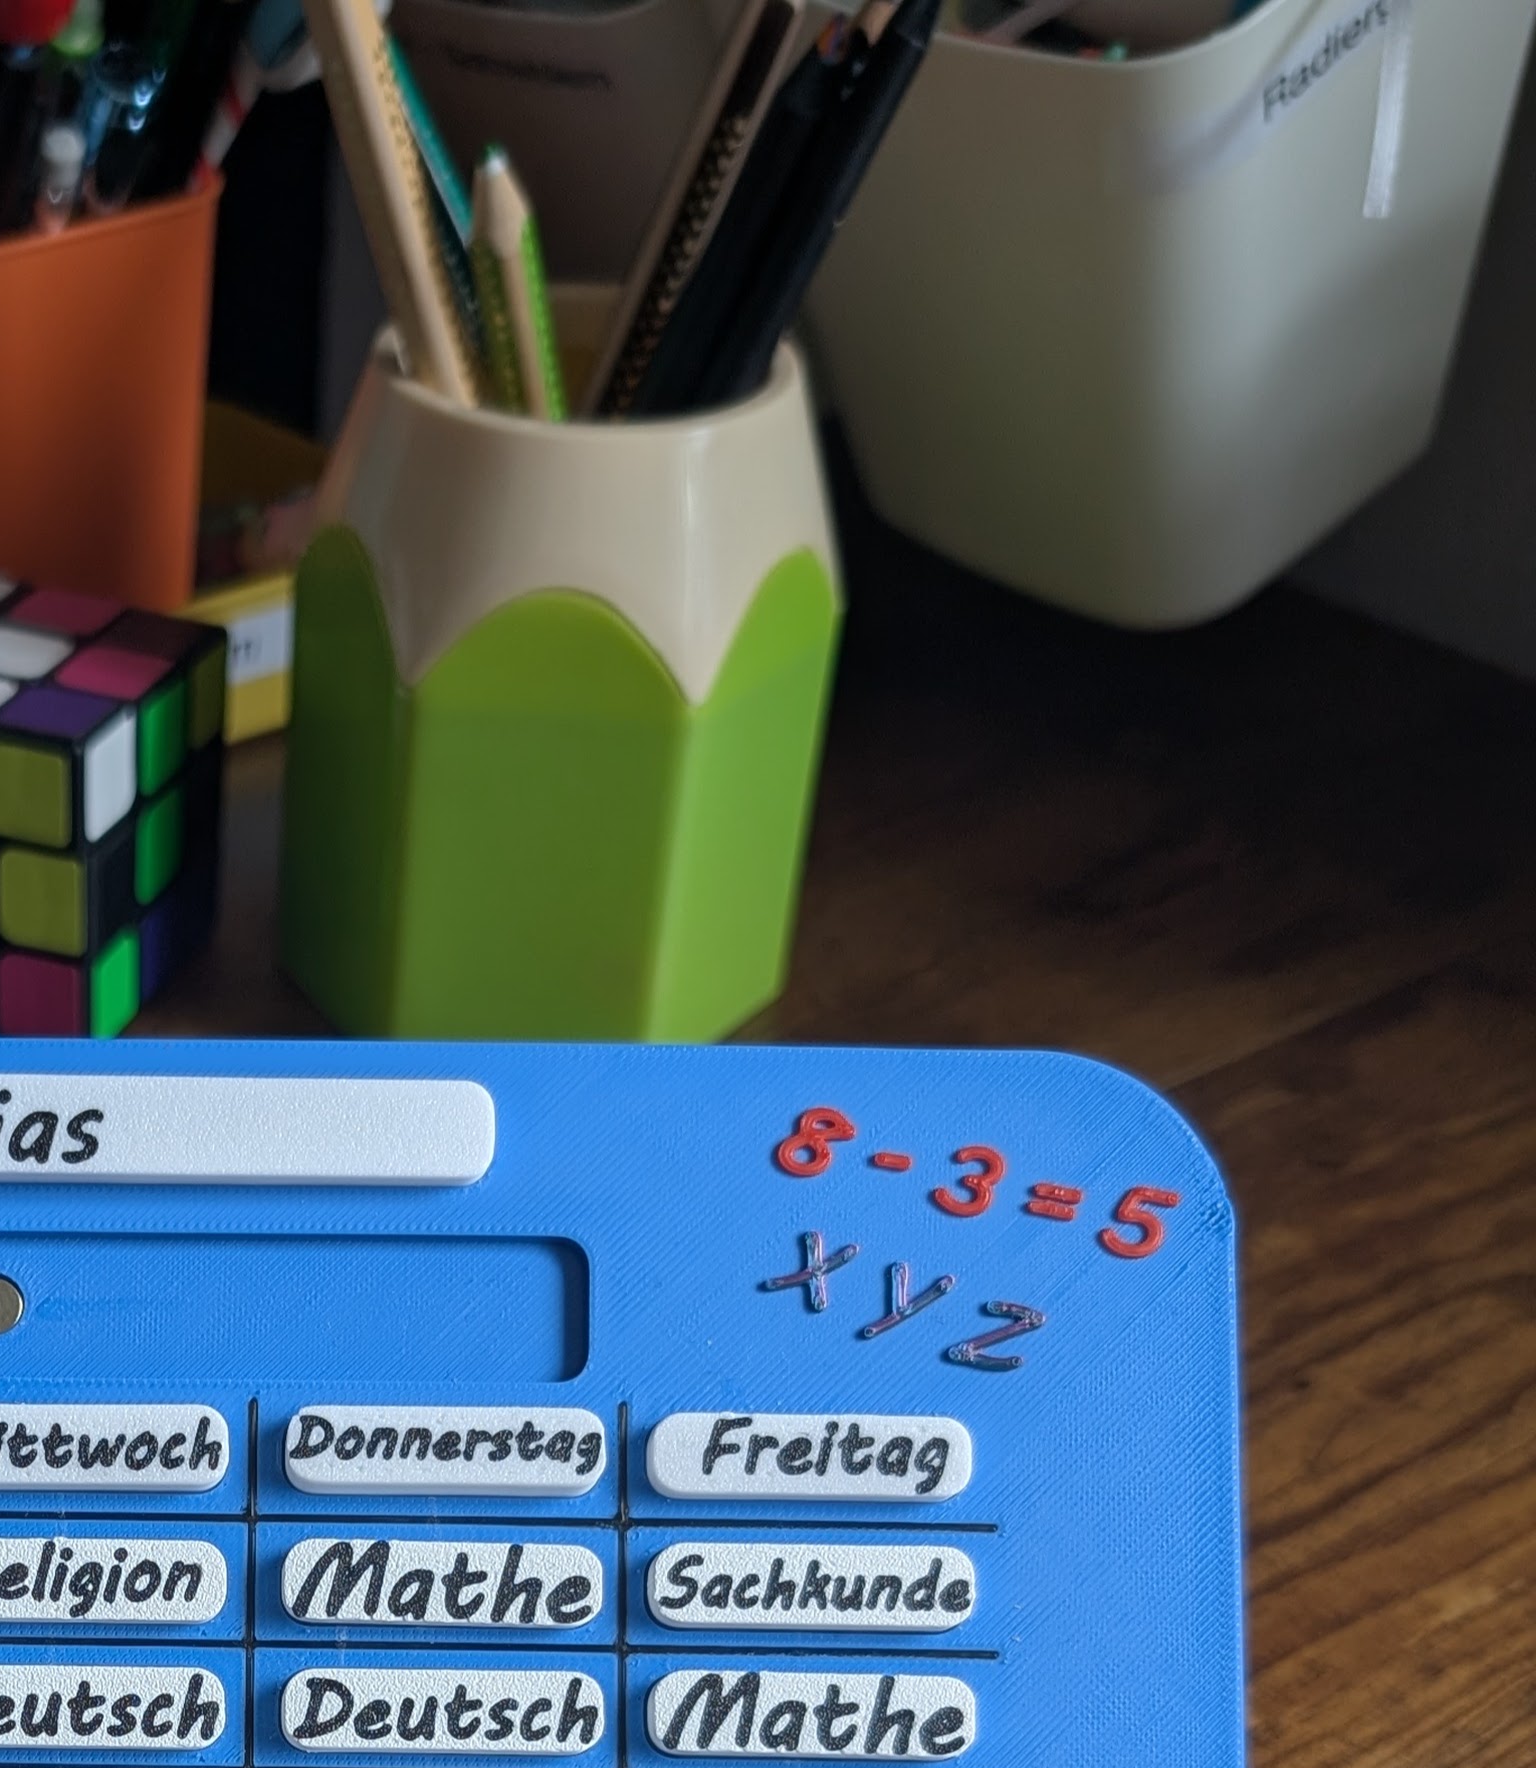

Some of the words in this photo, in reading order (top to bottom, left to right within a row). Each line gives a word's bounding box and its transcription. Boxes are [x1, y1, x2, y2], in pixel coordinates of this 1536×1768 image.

[289, 1416, 604, 1474] Donnerstag
[703, 1418, 951, 1493] Freitag
[291, 1543, 594, 1624] Mathe
[660, 1555, 971, 1611] Sachkunde
[295, 1678, 600, 1744] Deutsch
[662, 1674, 967, 1755] Mathe
